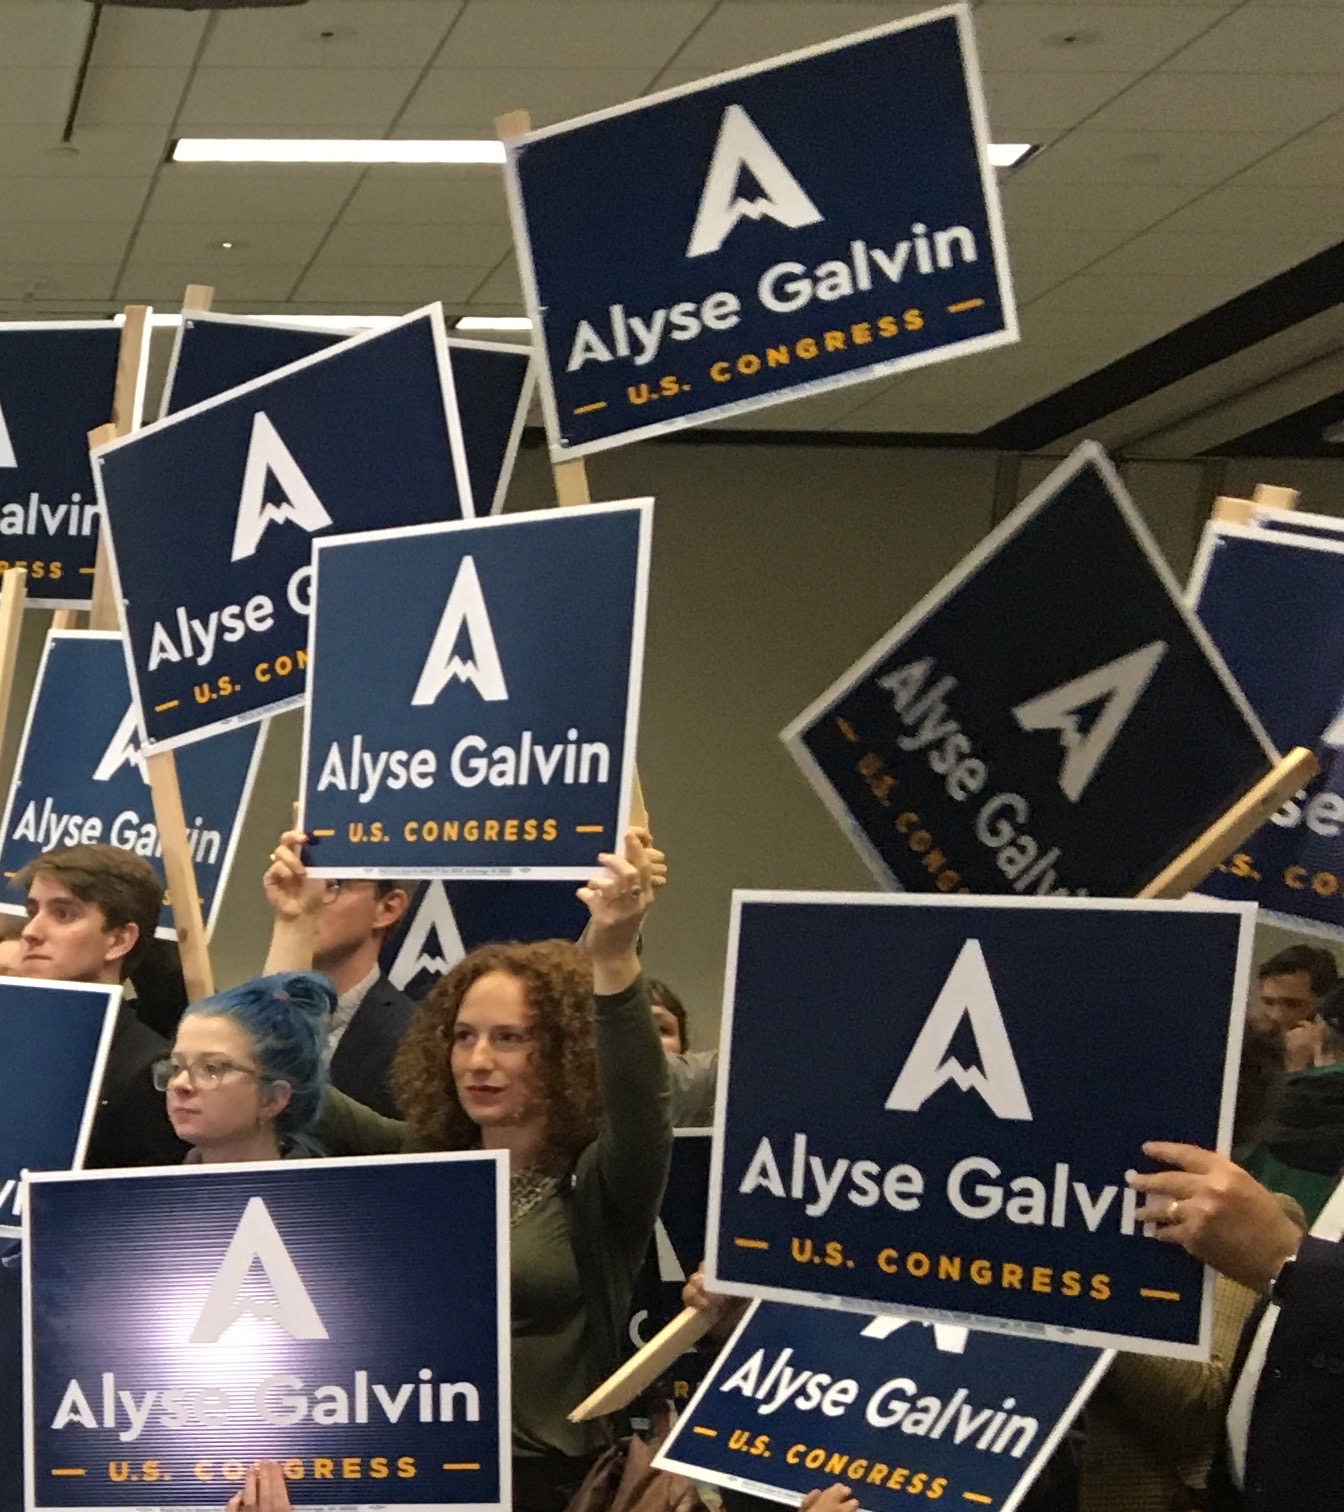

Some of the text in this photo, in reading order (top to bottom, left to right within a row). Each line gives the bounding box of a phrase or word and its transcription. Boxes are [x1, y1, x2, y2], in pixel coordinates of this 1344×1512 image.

[566, 221, 979, 374] Alyse Galvin
[627, 308, 927, 405] U.S. CONGRESS
[147, 594, 275, 671] Alyse
[194, 674, 241, 705] U.S.
[316, 728, 610, 804] Alyse Galvin
[876, 656, 989, 802] Alyse
[12, 797, 221, 865] Alyse Gain
[348, 819, 559, 842] U.S. CONGRESS
[895, 811, 970, 893] CONG
[739, 1132, 925, 1217] Alyse
[791, 1237, 1113, 1302] U.S. CONGRESS
[51, 1367, 480, 1443] Alyse Galvin
[720, 1347, 1039, 1458] Alyse Galvin
[108, 1456, 418, 1483] U.S. COGRESS
[728, 1429, 948, 1500] U.S. CONGRESS
